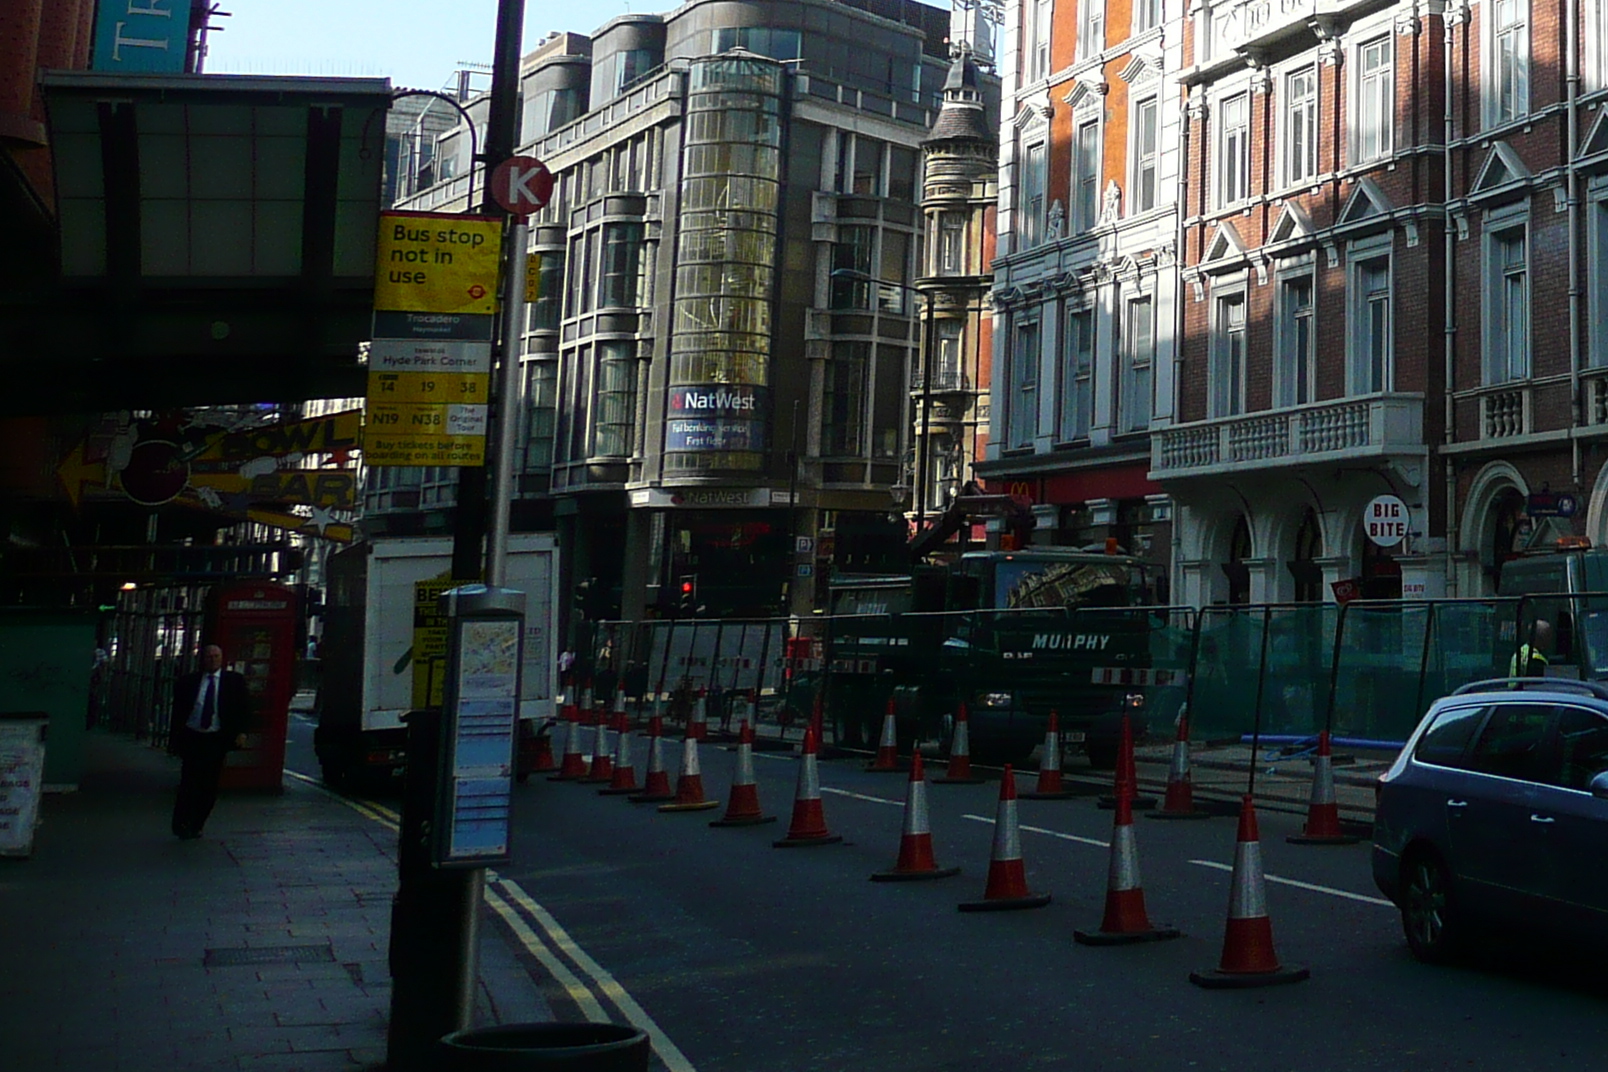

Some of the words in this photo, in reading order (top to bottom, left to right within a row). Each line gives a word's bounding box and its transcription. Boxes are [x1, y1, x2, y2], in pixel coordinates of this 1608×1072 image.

[509, 166, 542, 205] K
[393, 225, 430, 242] Bus
[436, 229, 484, 248] stop
[390, 249, 428, 263] not
[435, 248, 453, 264] in
[389, 270, 426, 284] use
[407, 314, 460, 324] Trocadero
[383, 356, 410, 367] Hyde
[414, 356, 436, 365] Park
[440, 356, 477, 366] Corner
[381, 382, 395, 392] 14
[421, 381, 435, 392] 19
[460, 382, 476, 393] 38
[685, 392, 755, 409] NatWest
[372, 414, 399, 424] N19
[411, 415, 441, 425] N38
[223, 419, 355, 456] BOWL
[375, 440, 394, 449] Buy
[689, 492, 749, 504] NatWest
[1374, 503, 1399, 518] BIG
[1370, 522, 1404, 537] BITE
